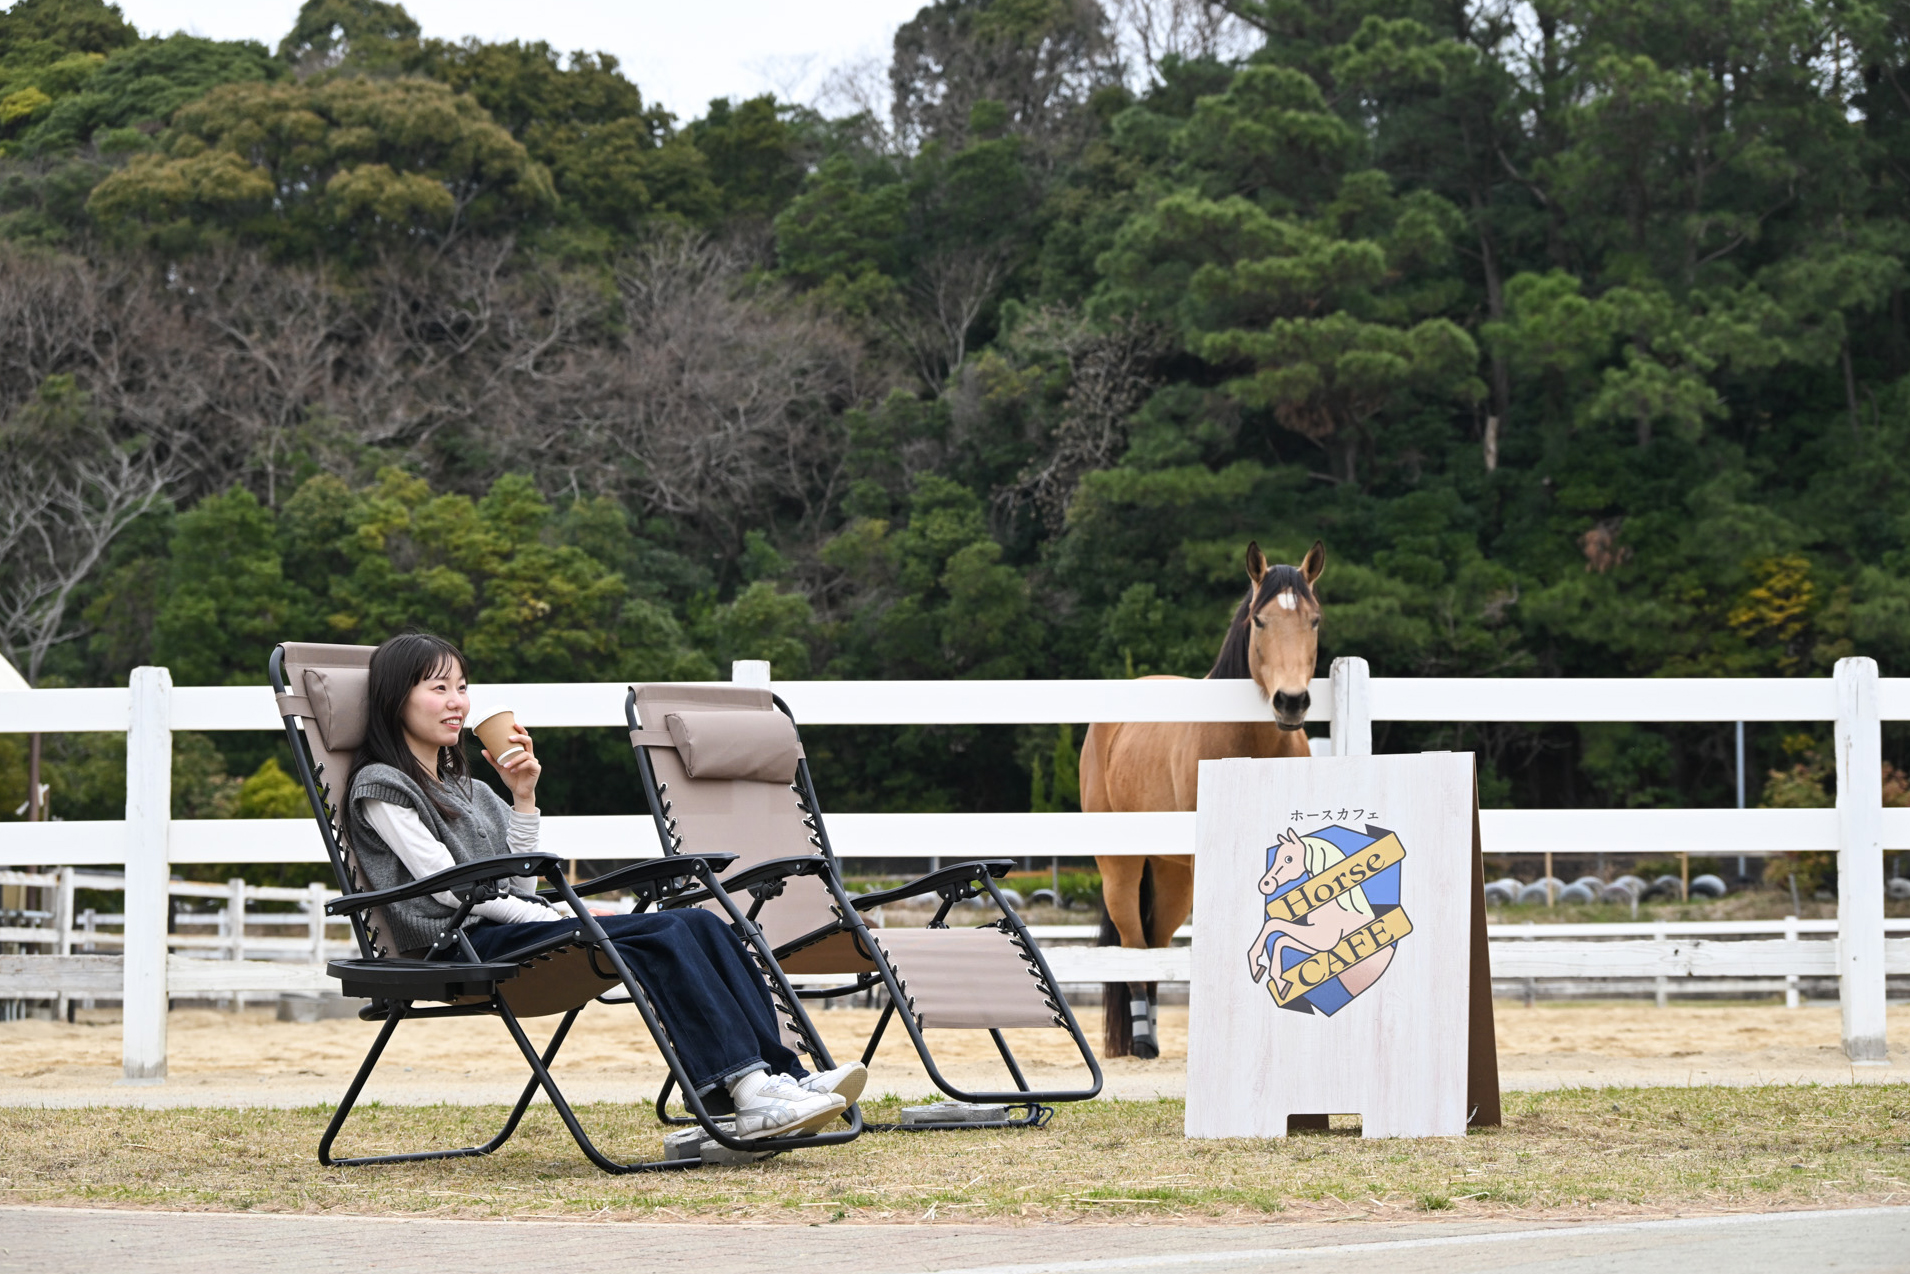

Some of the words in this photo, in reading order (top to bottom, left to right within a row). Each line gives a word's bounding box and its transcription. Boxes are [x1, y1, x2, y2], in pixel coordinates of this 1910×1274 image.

[1290, 808, 1379, 821] ホースカフェ
[1281, 852, 1386, 920] Horse
[1298, 919, 1394, 987] CAFE
